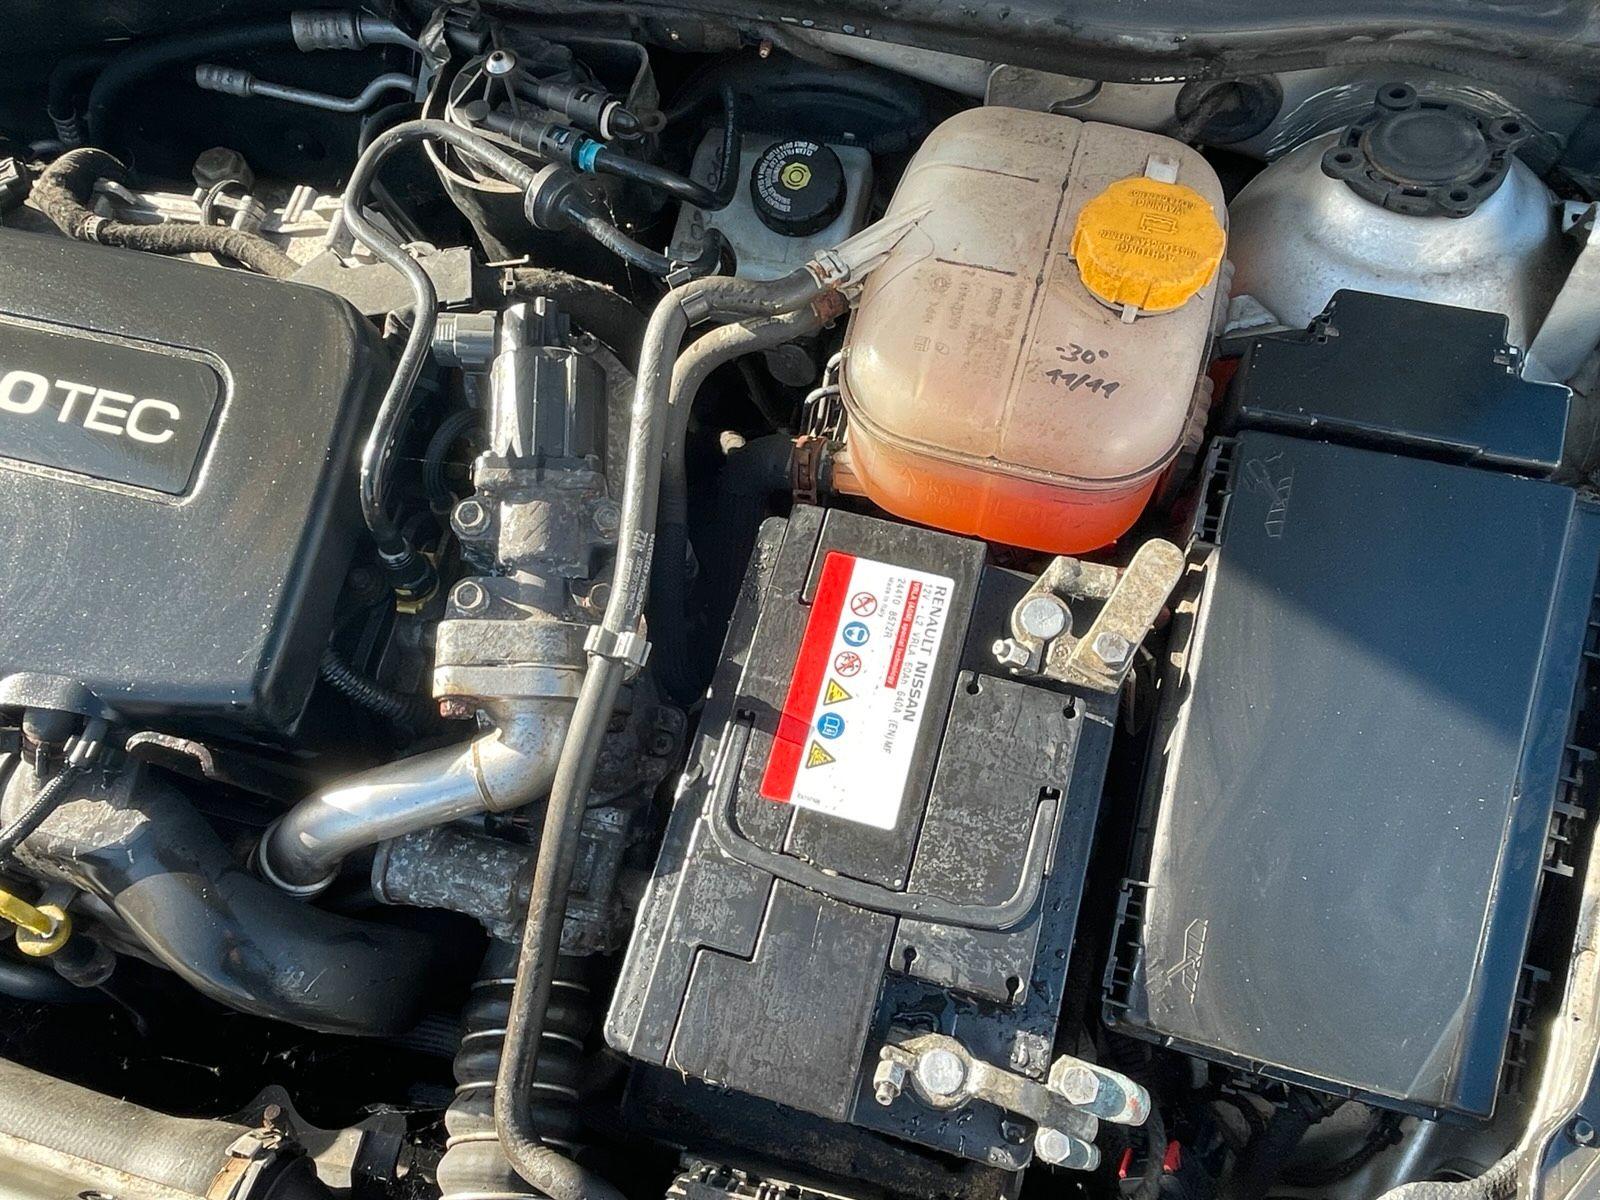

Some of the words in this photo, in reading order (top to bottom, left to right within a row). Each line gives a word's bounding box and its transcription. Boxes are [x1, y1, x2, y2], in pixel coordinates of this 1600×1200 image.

[891, 577, 906, 605] 24410
[920, 583, 932, 600] 12V
[882, 610, 898, 638] 8572R
[919, 585, 947, 655] RENAULT
[892, 690, 905, 714] 640A
[902, 660, 928, 723] NISSAN
